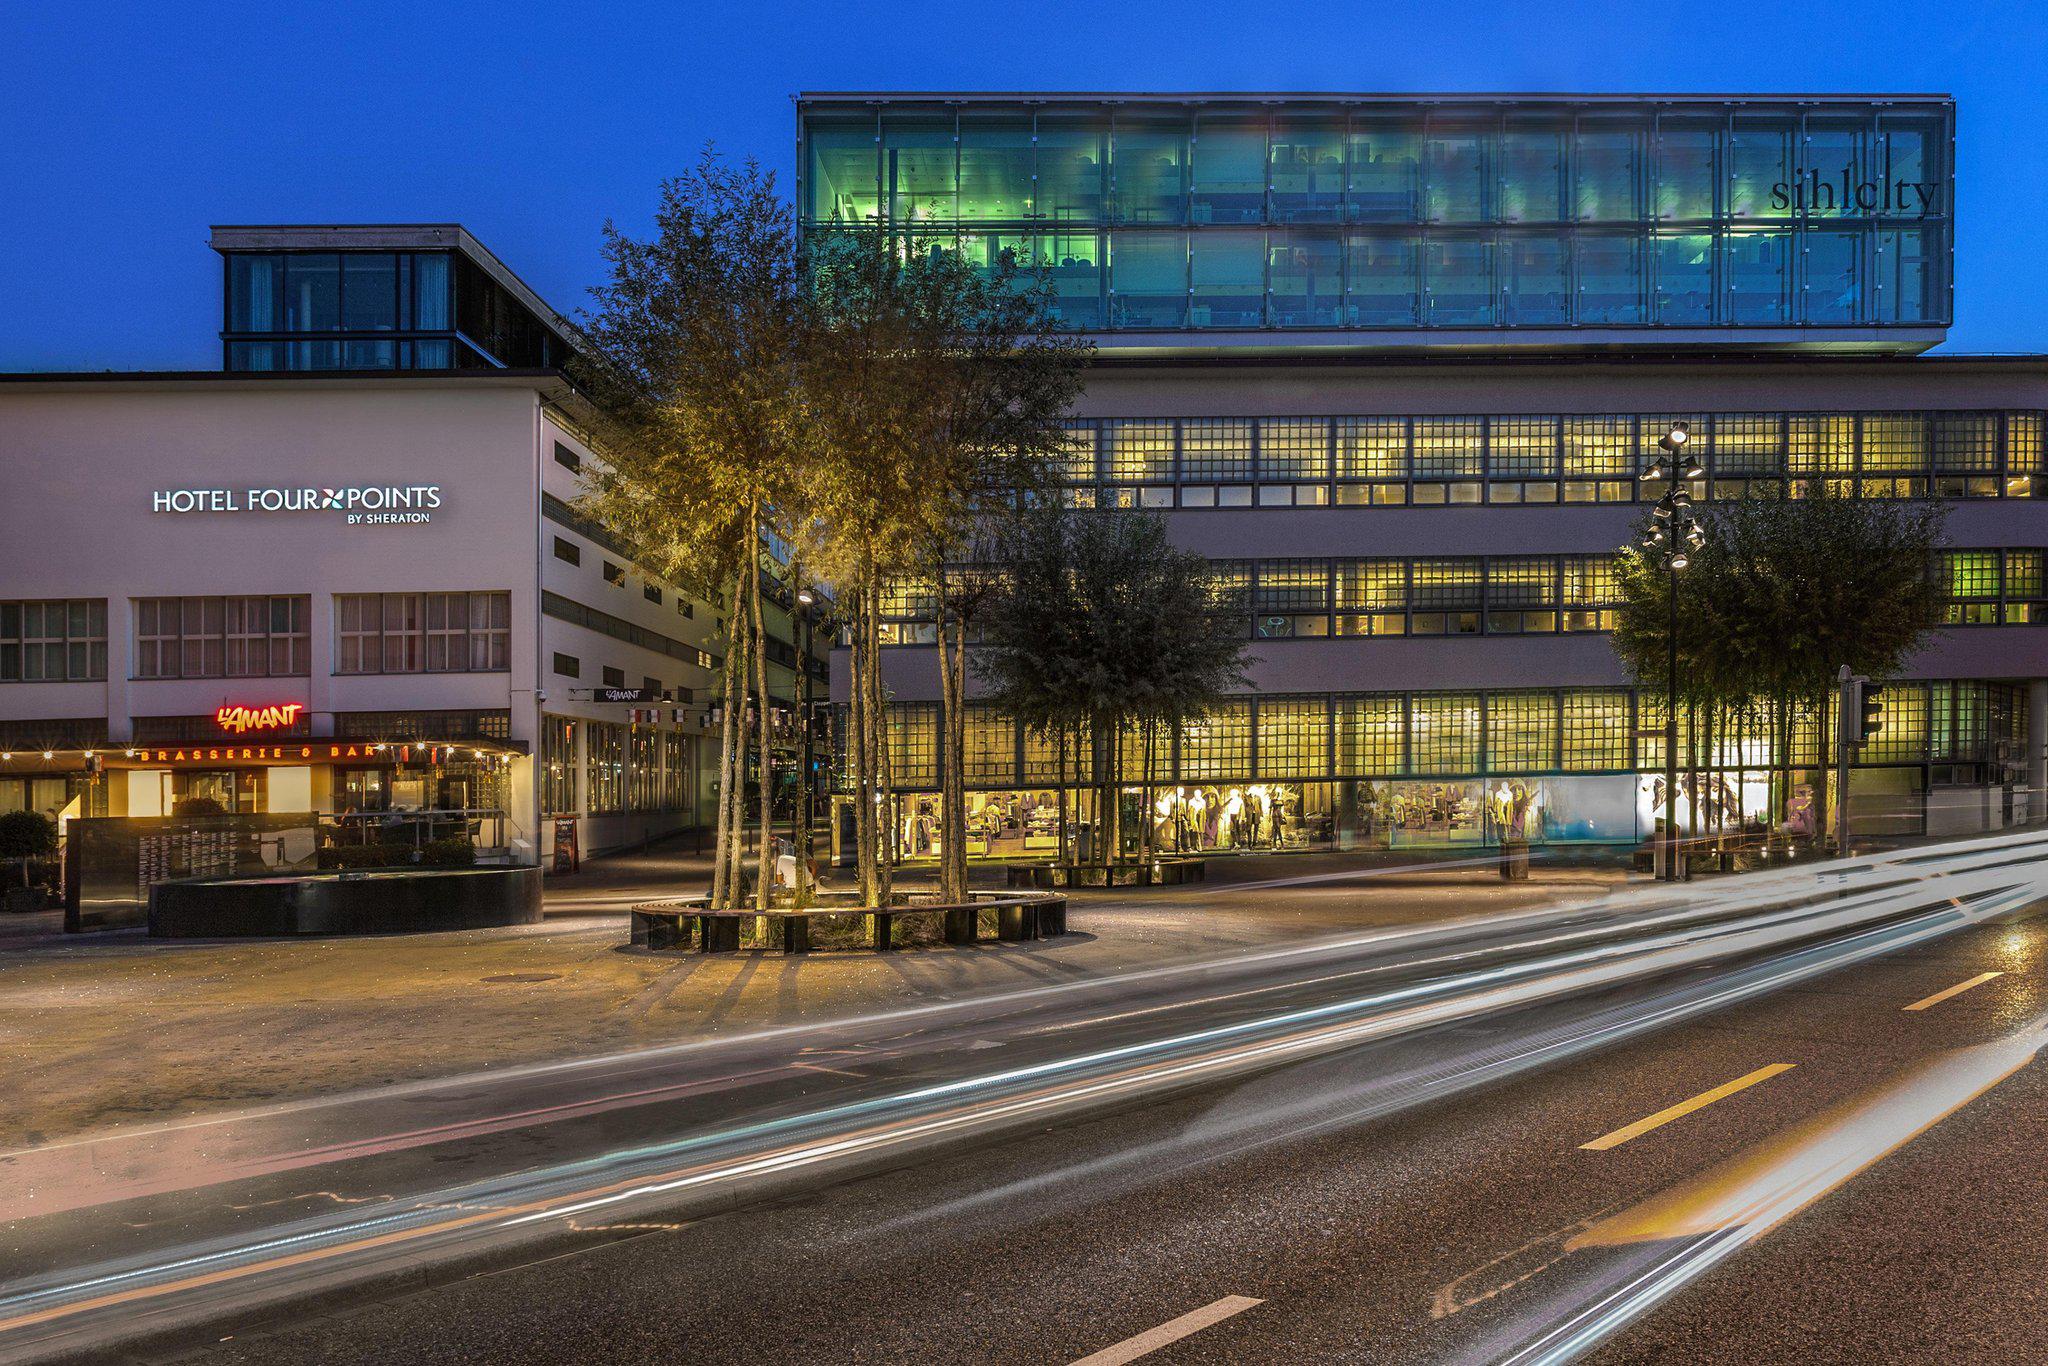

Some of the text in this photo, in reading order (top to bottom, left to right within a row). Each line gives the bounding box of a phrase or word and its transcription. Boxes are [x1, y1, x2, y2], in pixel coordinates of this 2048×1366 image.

[153, 487, 441, 512] HOTEL FOUR POINTS
[347, 513, 430, 524] BY SHERATON
[606, 690, 640, 700] L'AMANT
[217, 704, 303, 733] L'AMANT
[141, 748, 281, 761] BRASSERIE
[330, 745, 374, 757] BAR
